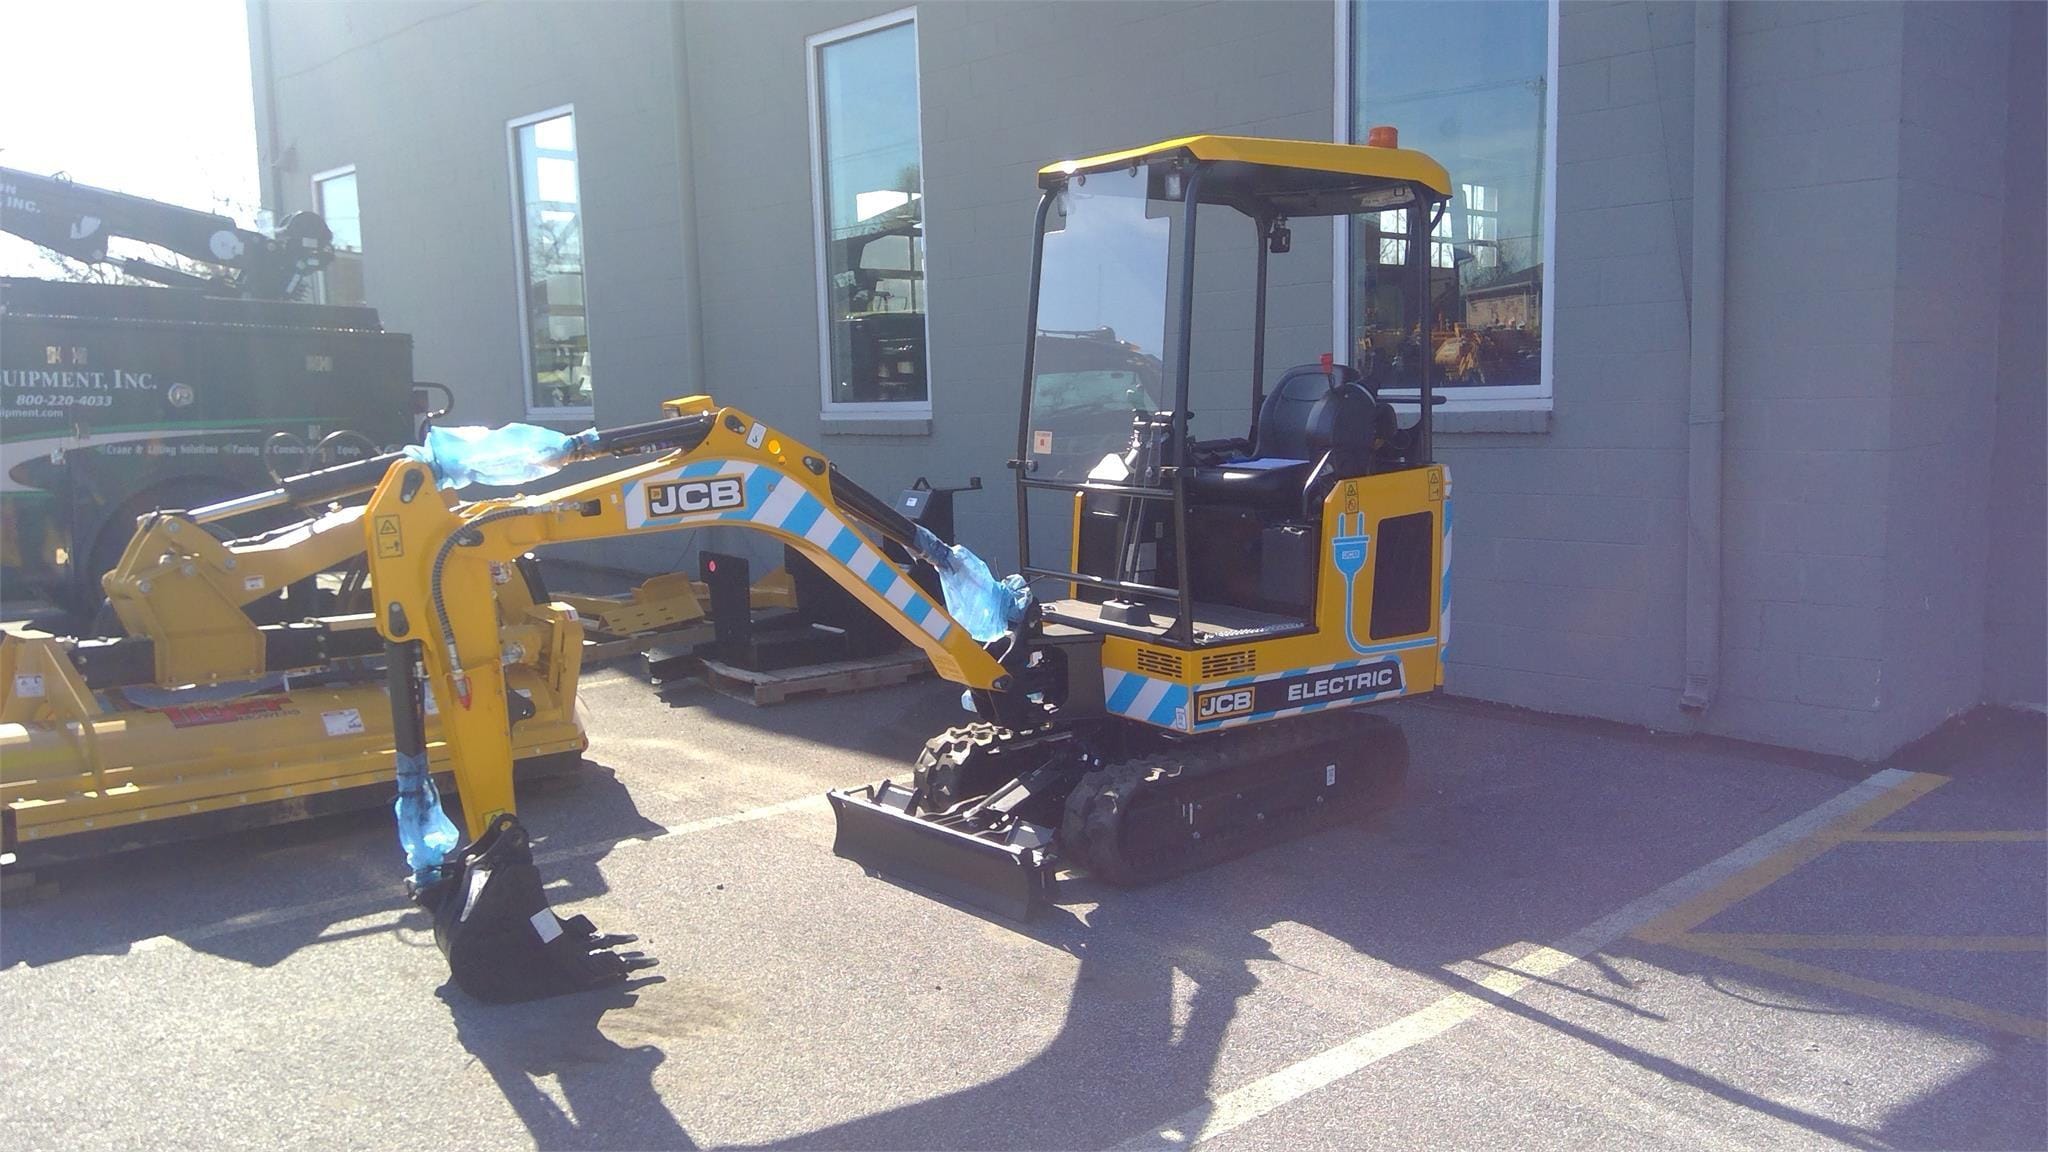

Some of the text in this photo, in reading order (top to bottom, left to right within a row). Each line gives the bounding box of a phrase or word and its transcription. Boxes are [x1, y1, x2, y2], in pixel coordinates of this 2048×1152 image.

[0, 369, 158, 391] UIPMENT, INC.
[16, 393, 113, 408] 800-220-4033
[651, 479, 742, 515] JCB
[1201, 668, 1393, 717] JCB ELECTRIC
